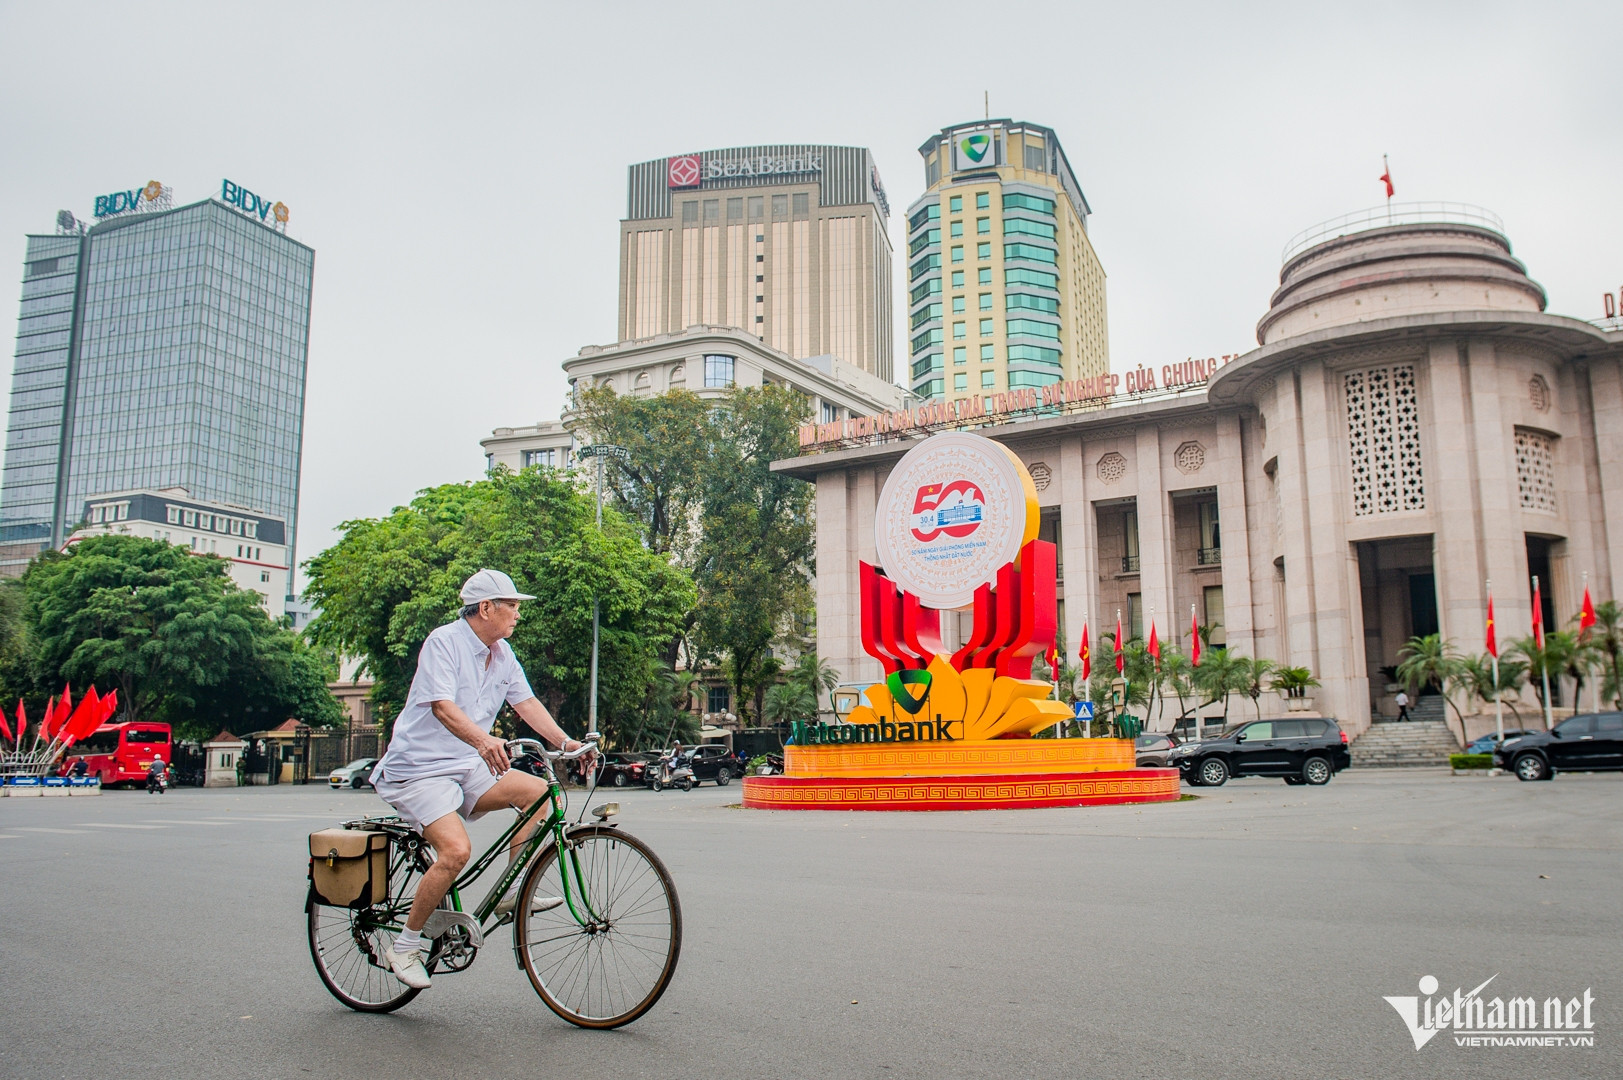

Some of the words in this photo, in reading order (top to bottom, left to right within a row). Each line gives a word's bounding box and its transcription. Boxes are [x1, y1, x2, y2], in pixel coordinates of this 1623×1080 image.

[708, 152, 821, 178] SeABank
[94, 187, 144, 217] BIDV
[222, 179, 272, 220] BIDV
[959, 394, 986, 420] MÃI
[990, 387, 1037, 415] TRONG
[1042, 380, 1061, 407] SỰ
[1065, 372, 1119, 402] NGHIỆP
[1126, 363, 1156, 394] CỦA
[1162, 357, 1216, 388] CHÚNG
[911, 480, 986, 542] 50
[791, 714, 956, 745] Vietcombank
